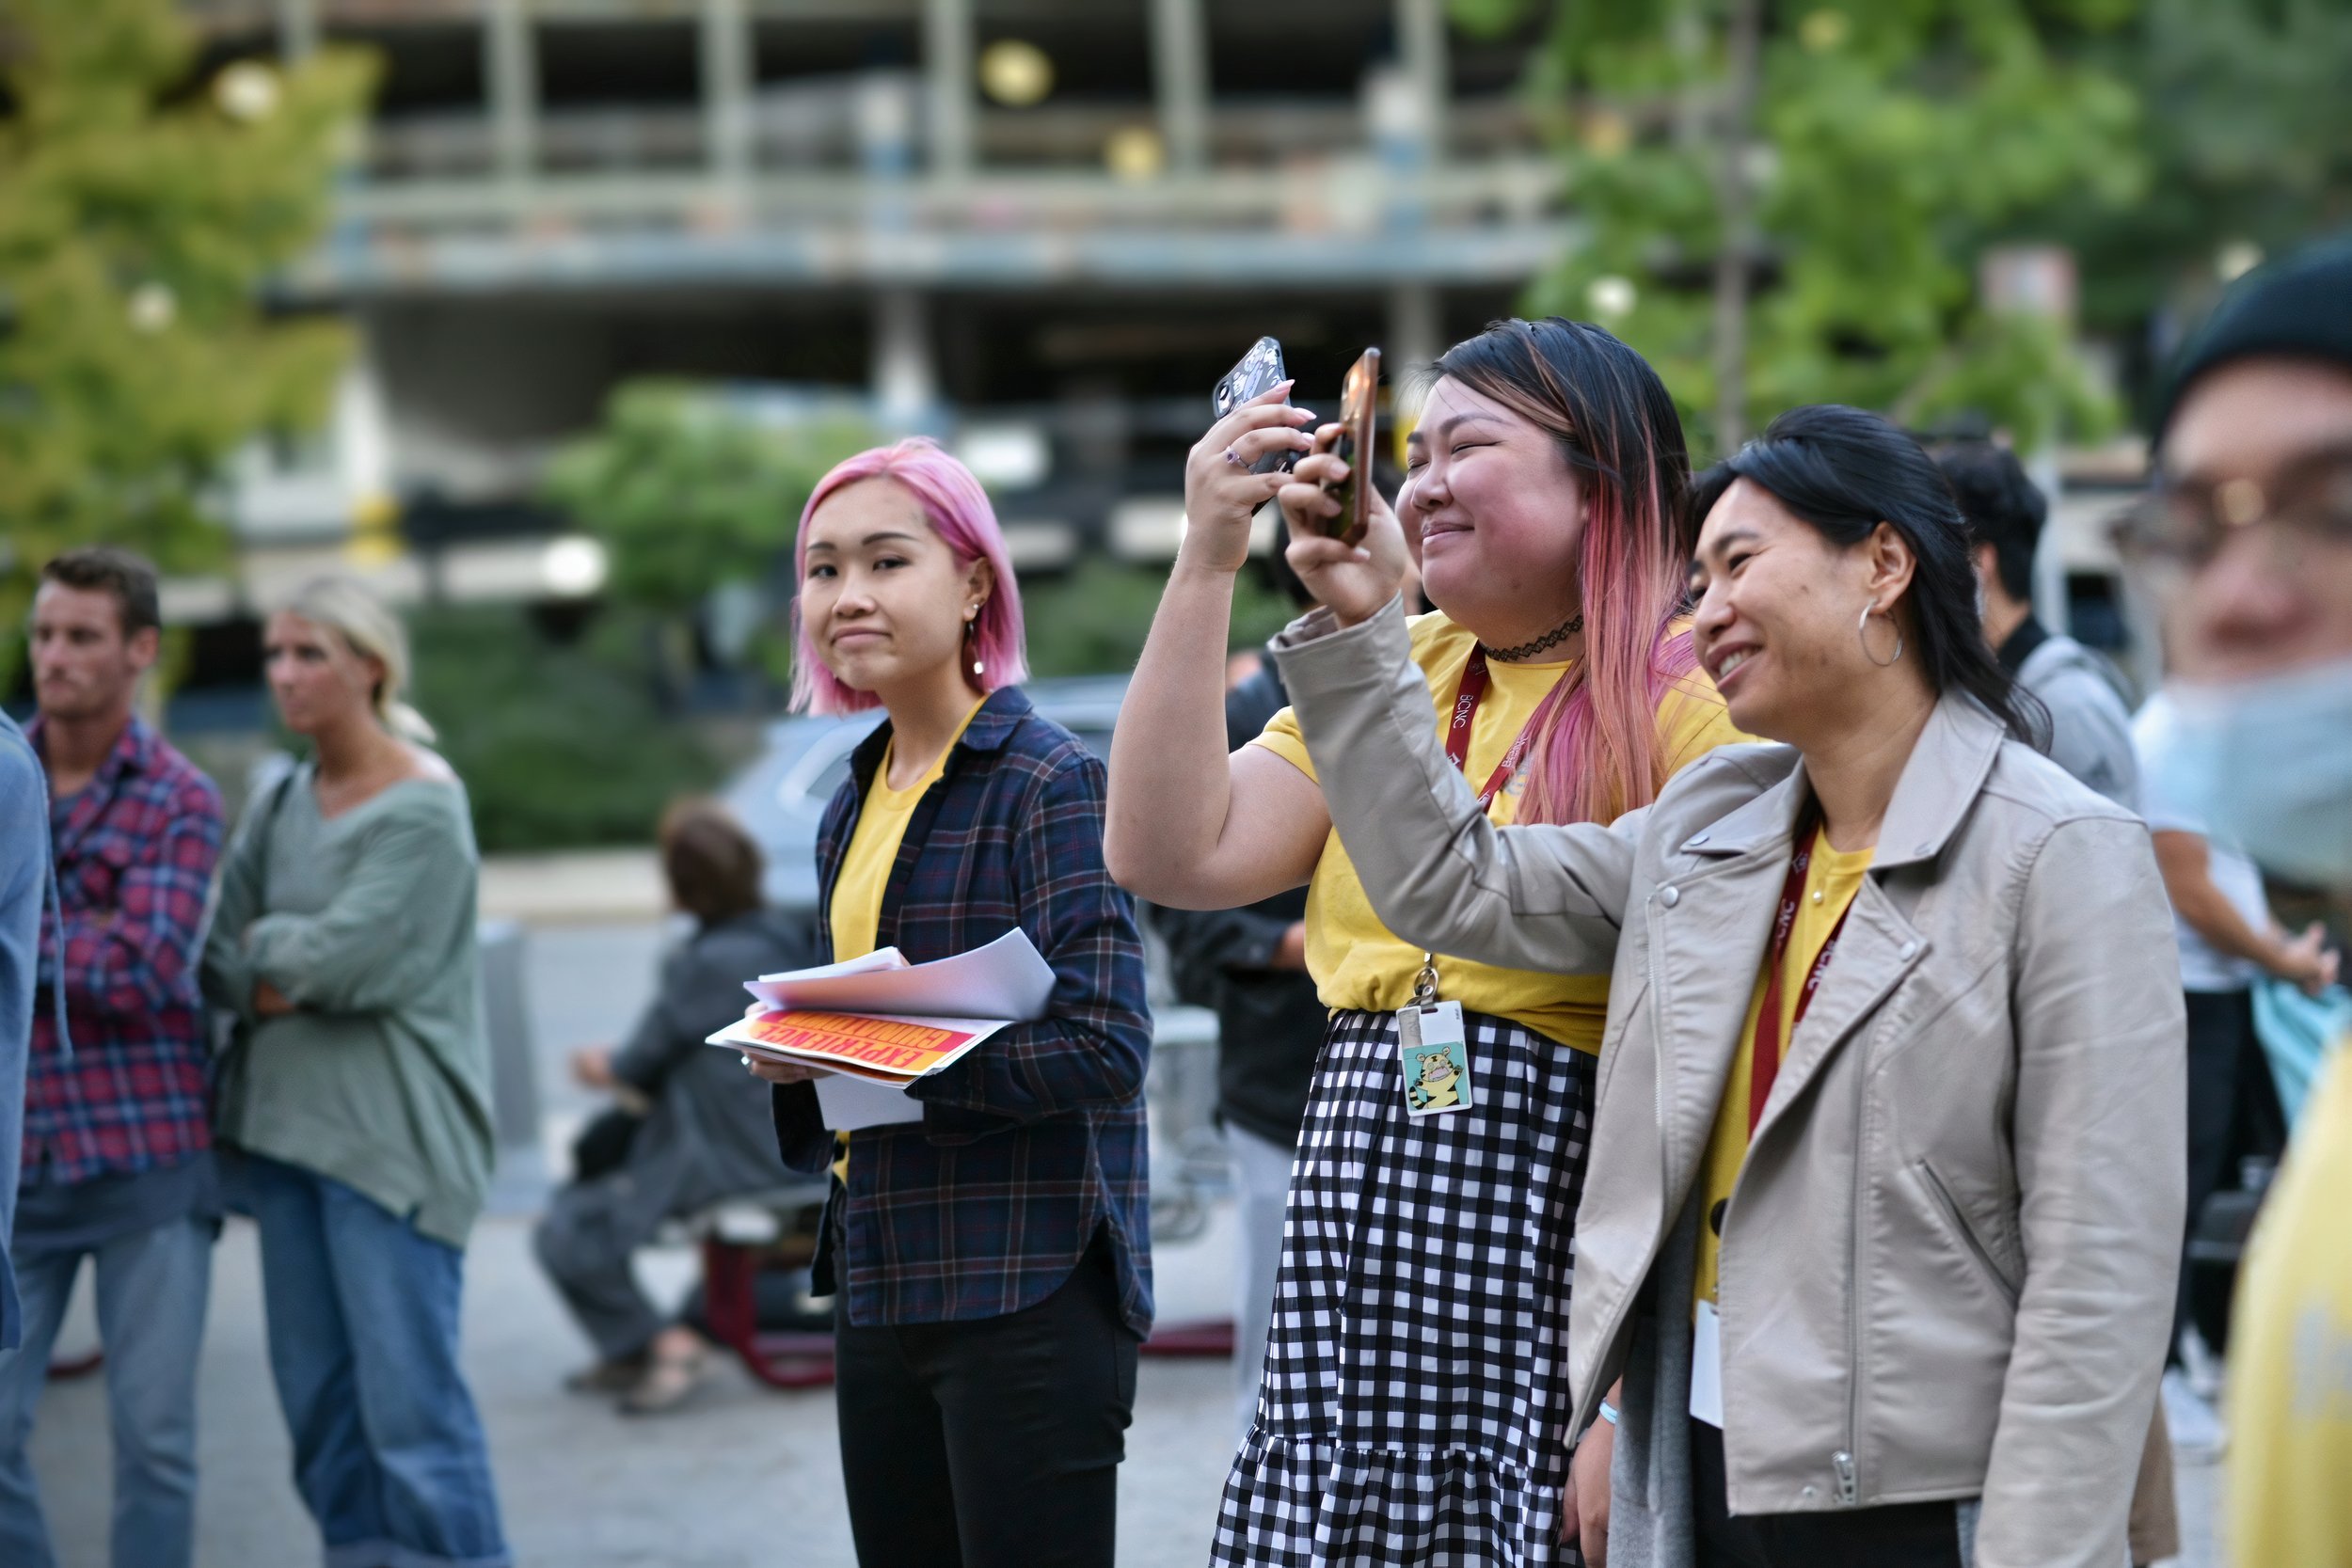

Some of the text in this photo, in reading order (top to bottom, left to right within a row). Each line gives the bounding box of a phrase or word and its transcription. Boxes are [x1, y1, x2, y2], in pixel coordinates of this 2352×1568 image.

[1453, 694, 1474, 729] BCNC
[759, 1025, 924, 1069] EXPERIENCE
[779, 1010, 953, 1049] CHINATOWN
